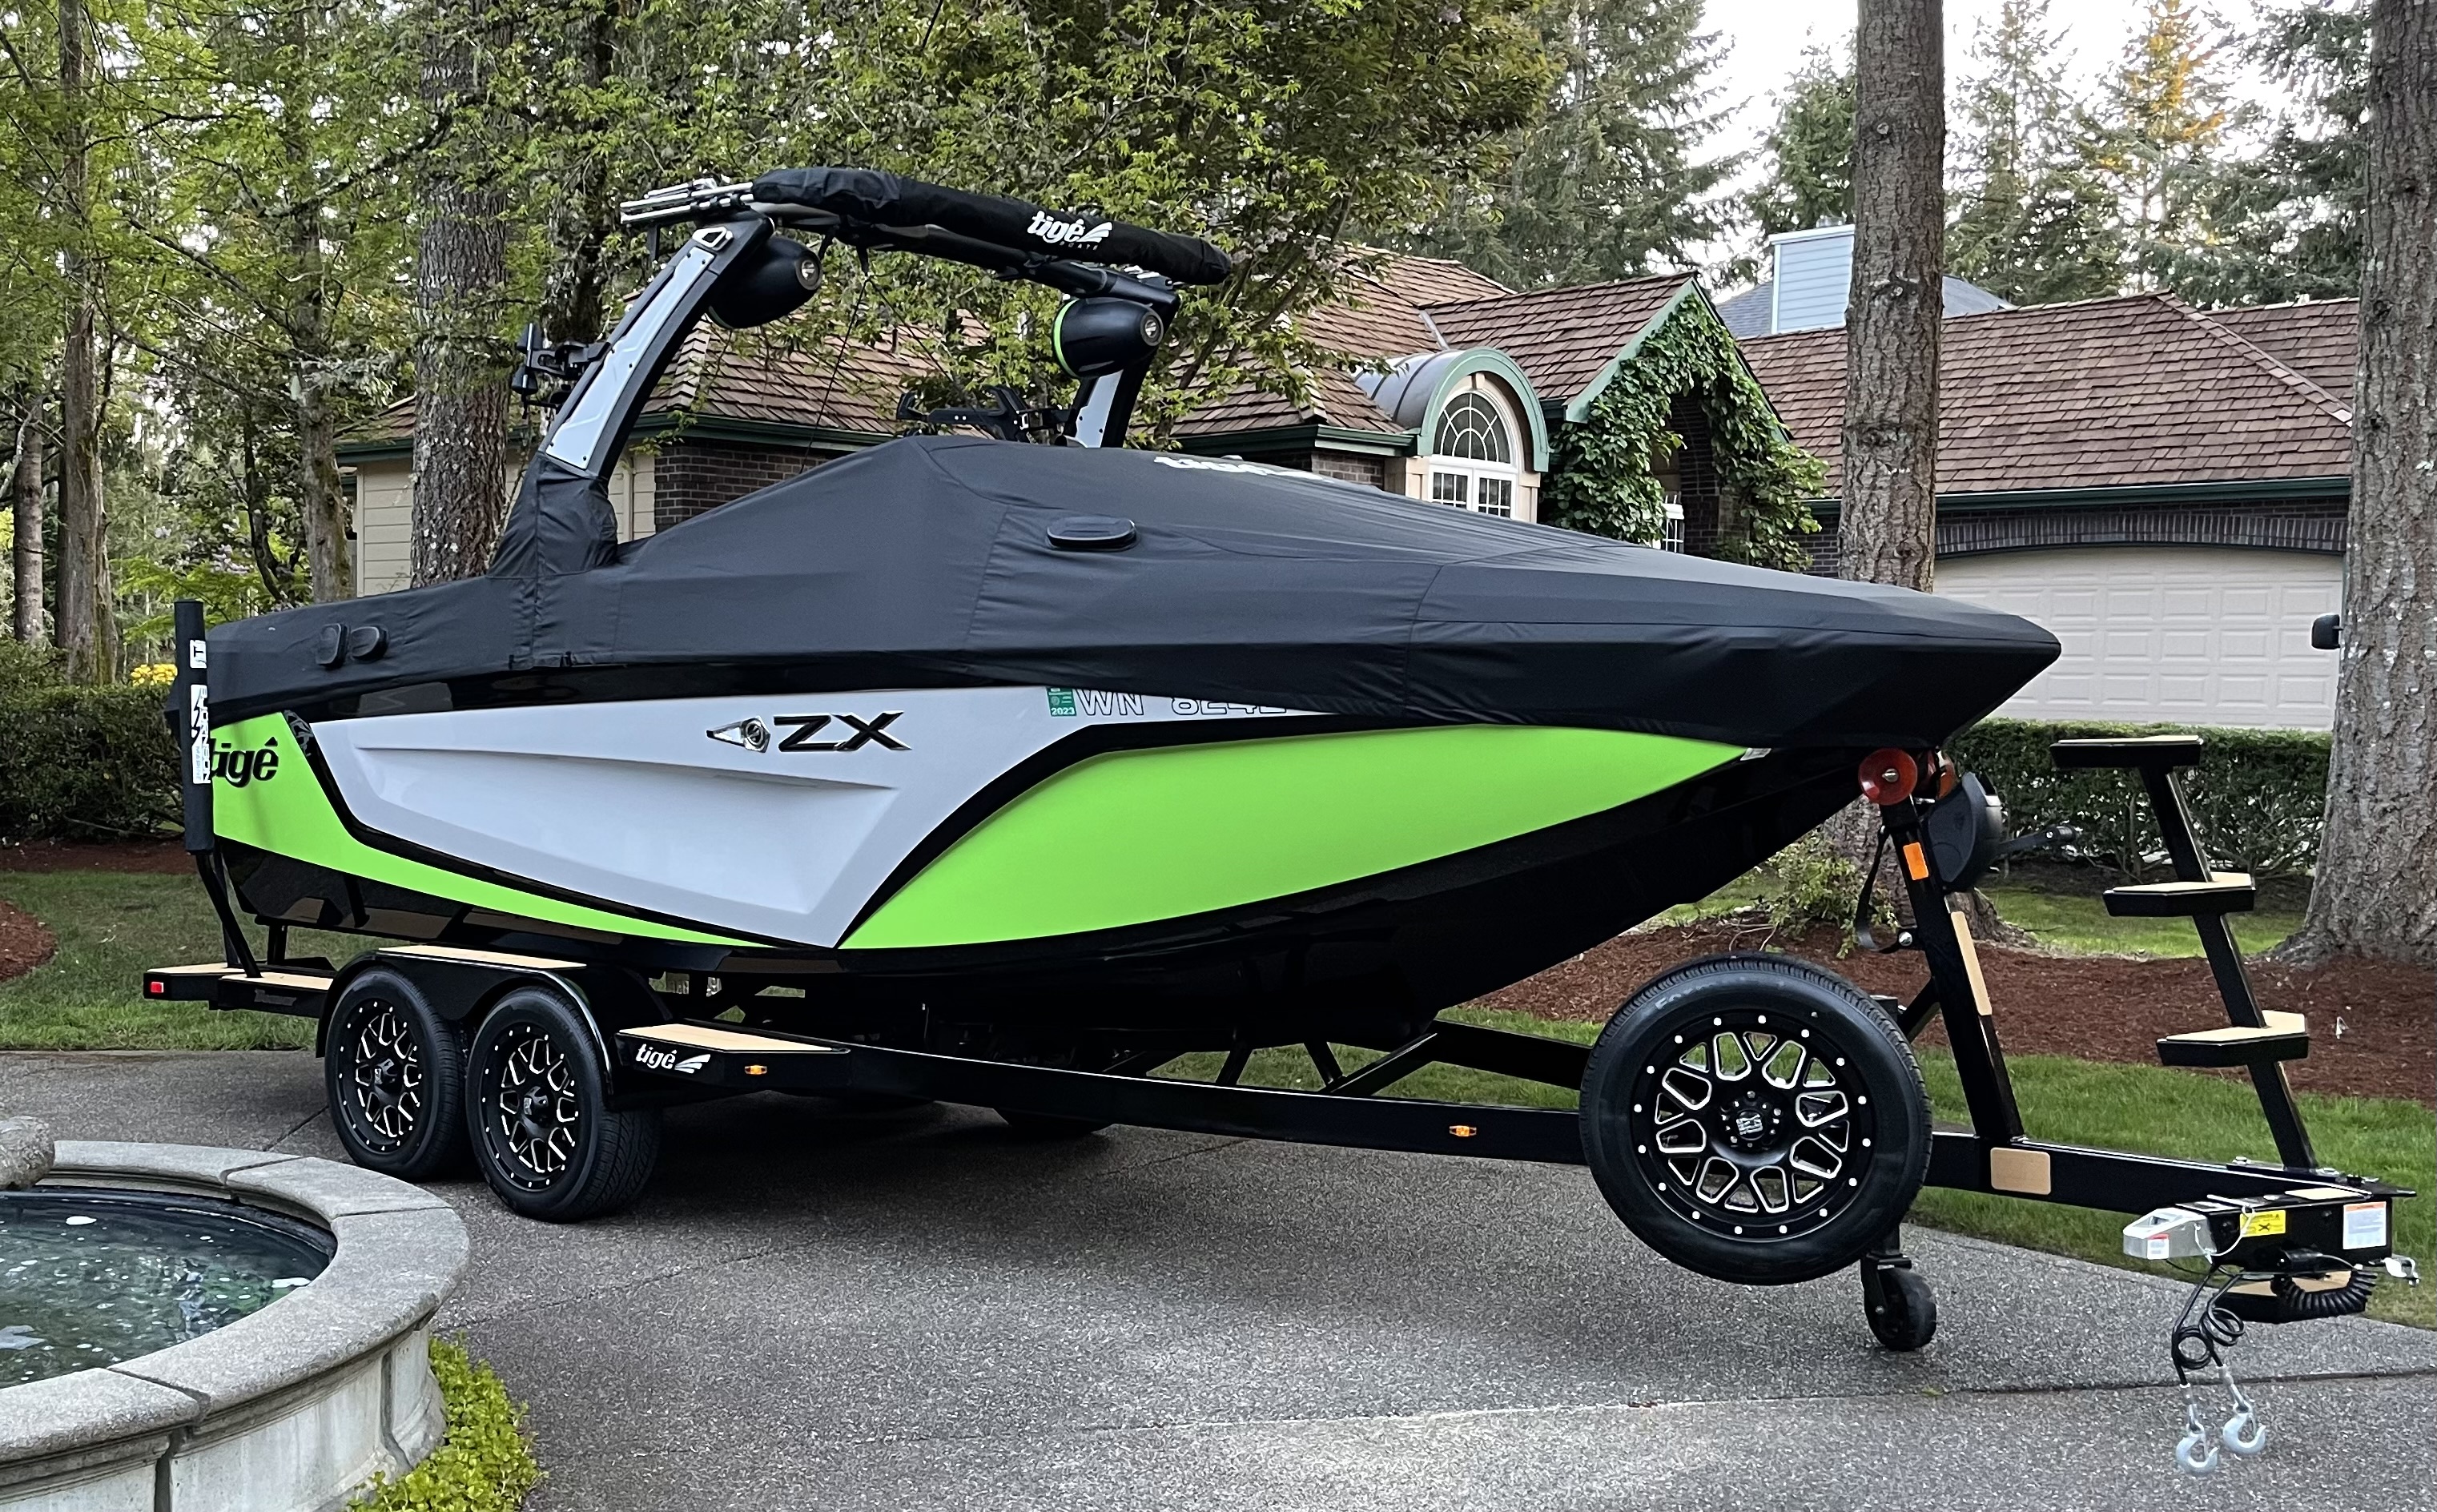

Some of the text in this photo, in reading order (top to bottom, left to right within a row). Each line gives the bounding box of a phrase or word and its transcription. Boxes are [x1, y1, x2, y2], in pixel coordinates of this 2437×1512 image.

[1051, 707, 1075, 715] 2023
[1076, 689, 1144, 715] WN
[774, 710, 912, 753] ZX
